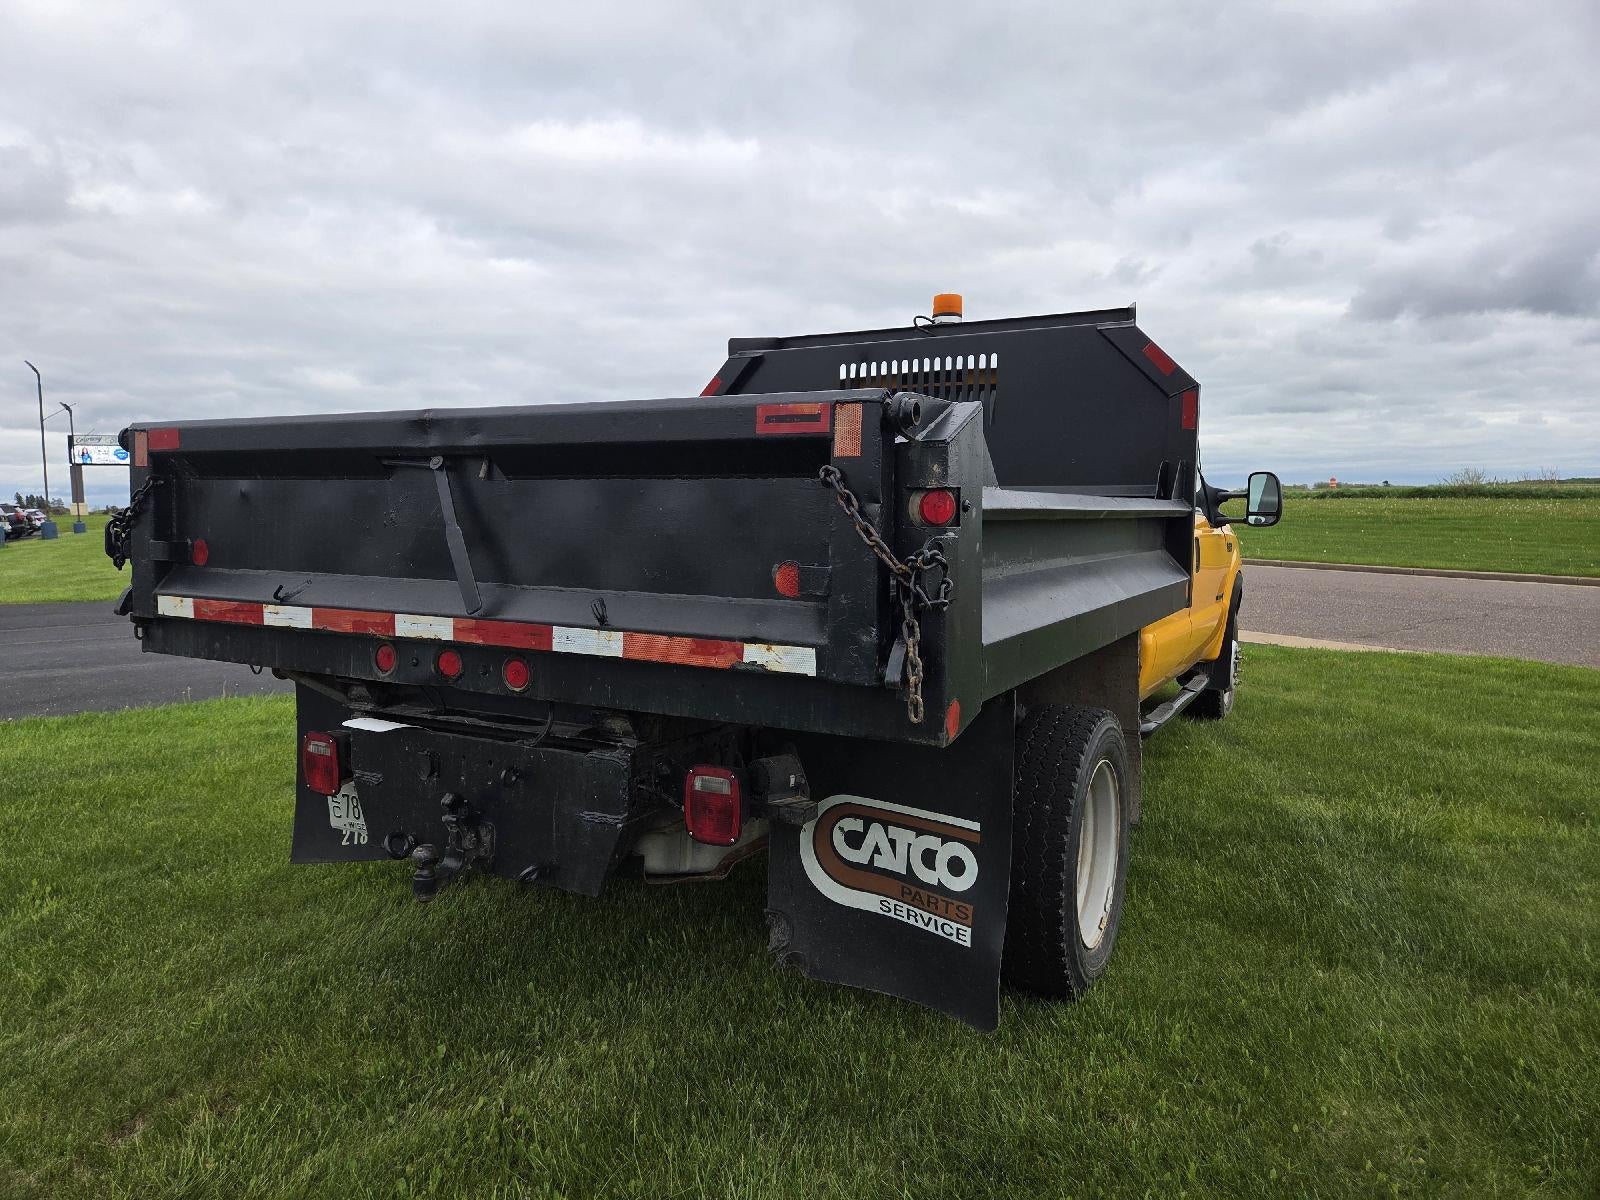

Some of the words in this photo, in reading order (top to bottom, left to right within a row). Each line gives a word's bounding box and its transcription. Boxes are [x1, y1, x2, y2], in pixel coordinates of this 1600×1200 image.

[832, 817, 979, 892] CATCO
[879, 899, 969, 943] SERVICE
[900, 884, 970, 921] PARTS
